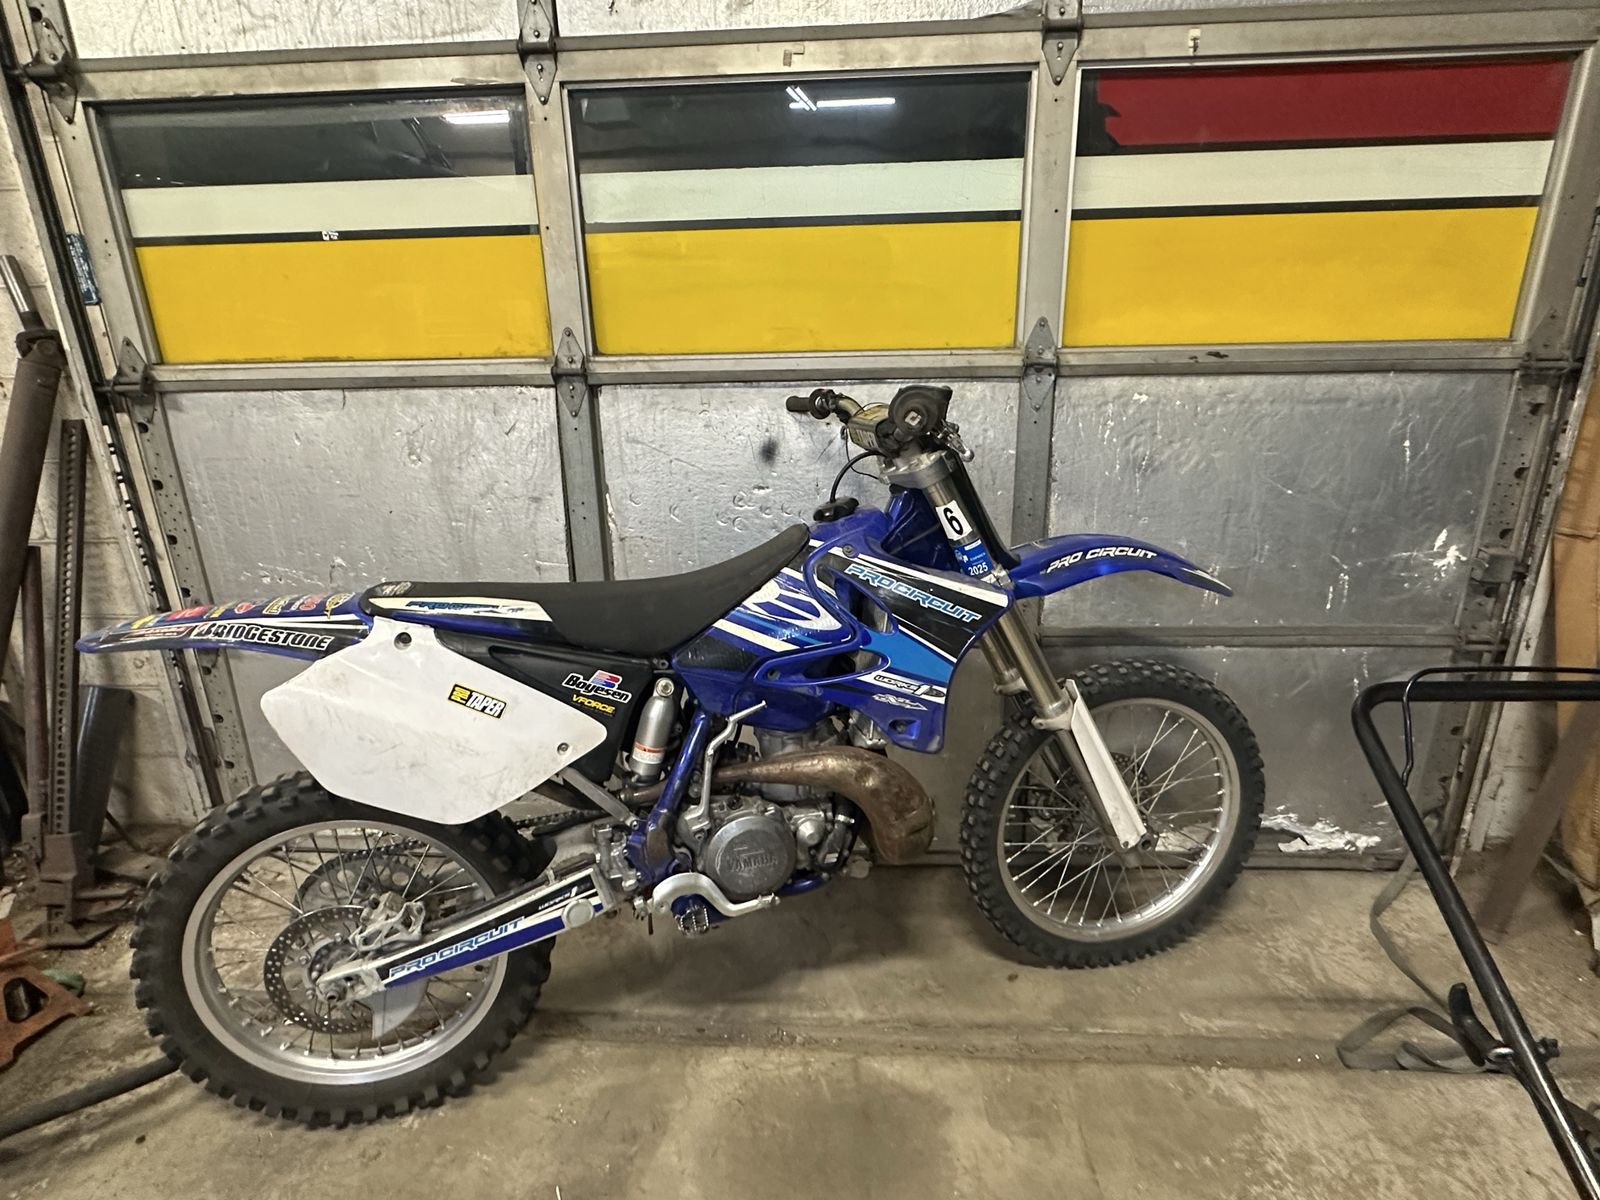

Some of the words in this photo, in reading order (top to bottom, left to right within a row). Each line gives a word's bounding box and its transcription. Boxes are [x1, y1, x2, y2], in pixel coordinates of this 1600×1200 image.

[943, 507, 964, 536] 6
[967, 561, 989, 576] 2025
[1046, 552, 1084, 574] PRO
[1085, 546, 1158, 559] CIRCUIT
[844, 563, 893, 590] PRO
[892, 582, 983, 623] CIRCUIT
[192, 622, 334, 650] BRIDGESTONE
[562, 673, 632, 703] Boyesen
[465, 691, 506, 717] TAPER
[572, 693, 616, 714] VFORCE
[389, 953, 438, 978] PRO
[437, 915, 526, 962] CIRCUIT
